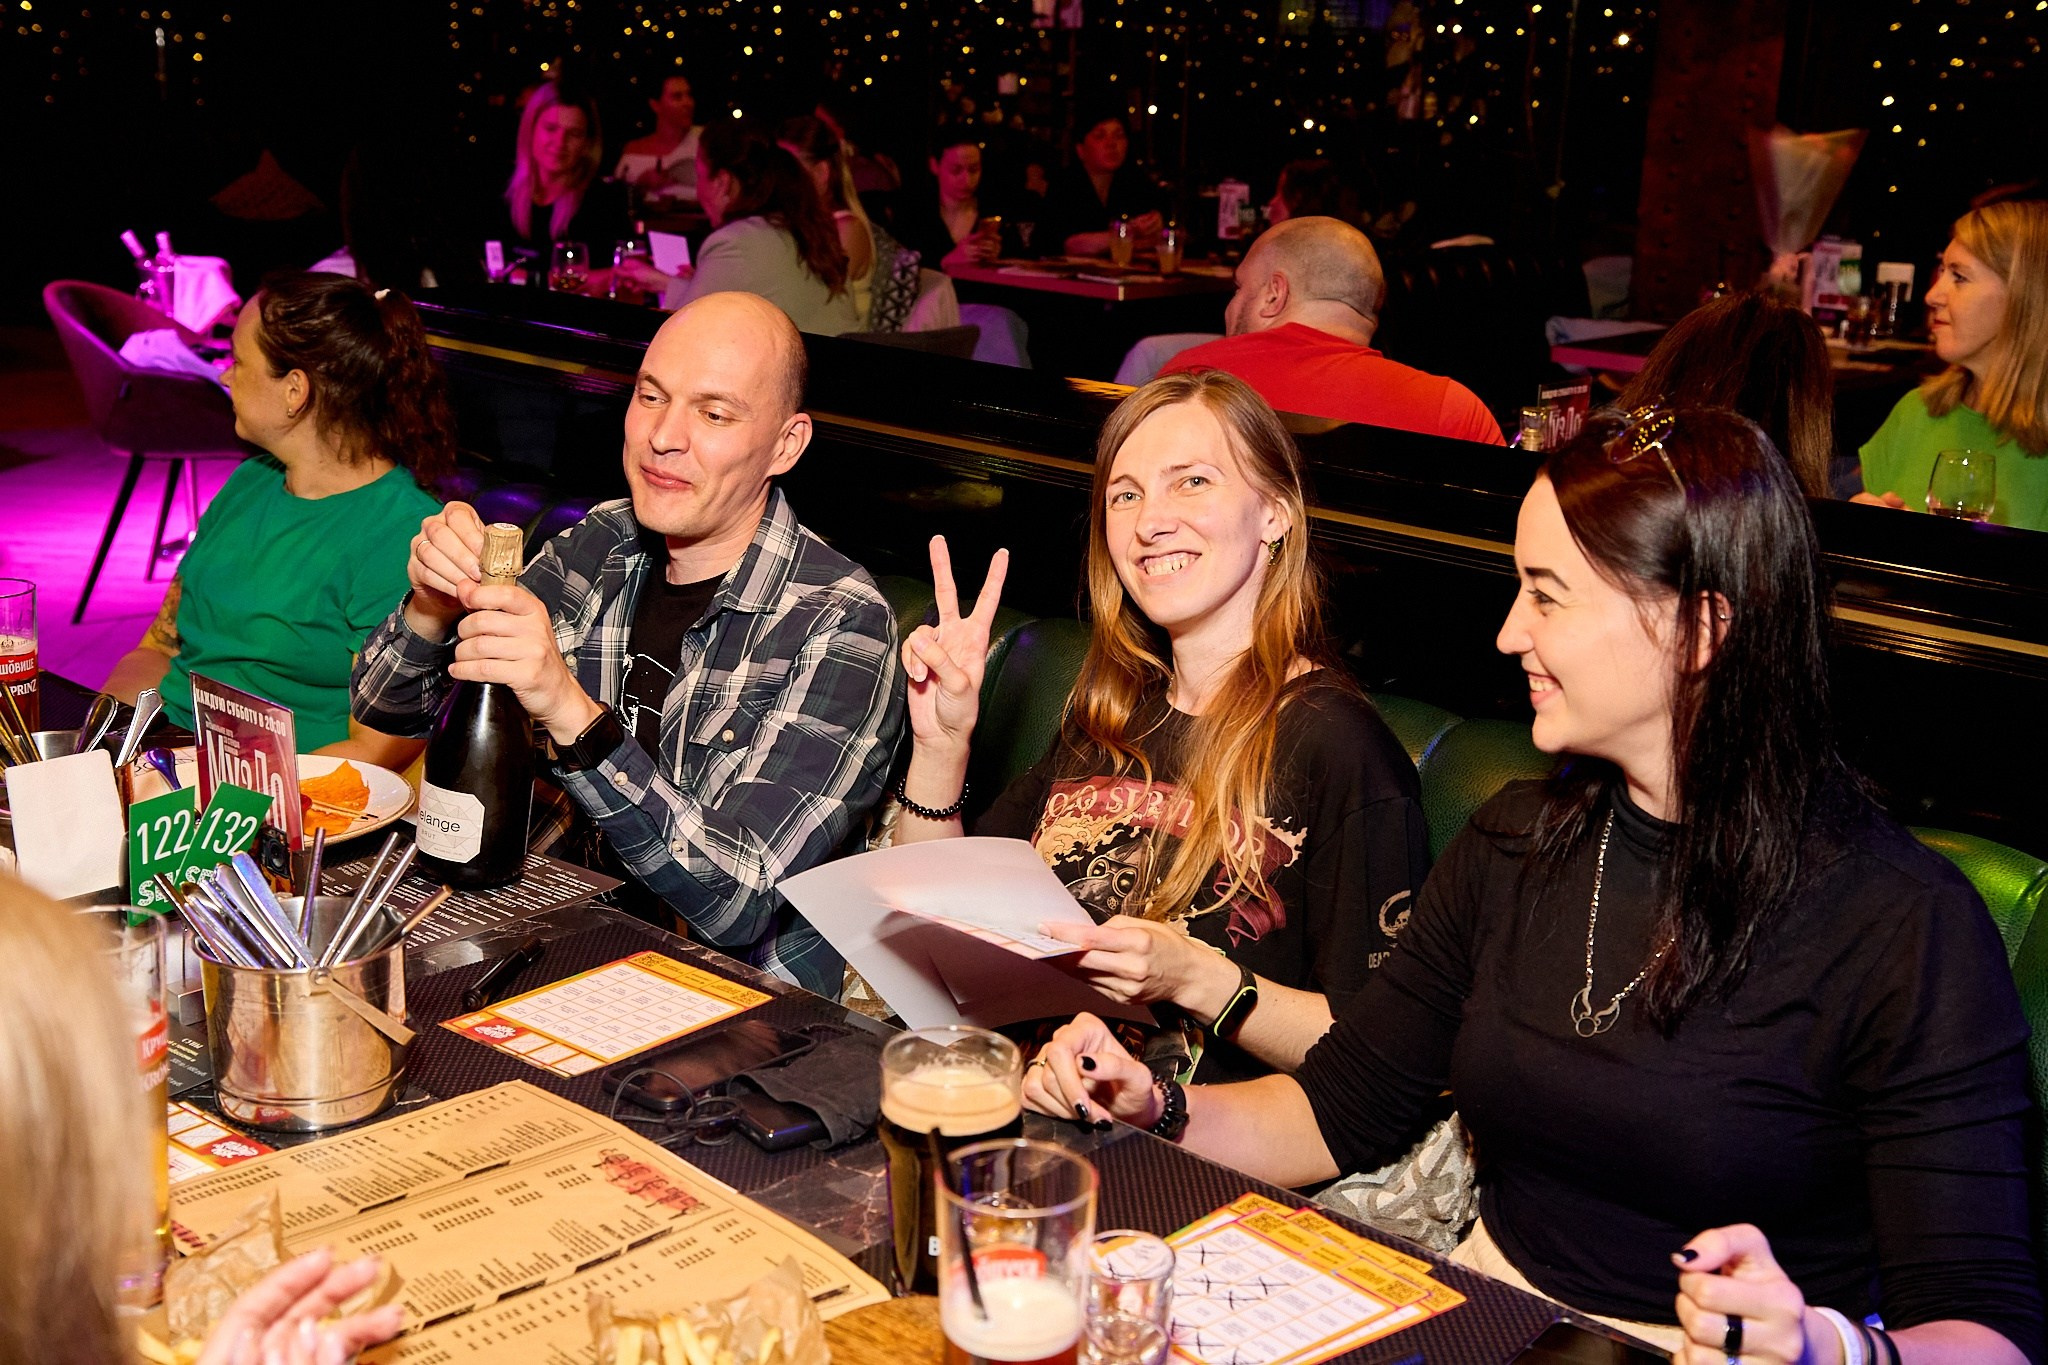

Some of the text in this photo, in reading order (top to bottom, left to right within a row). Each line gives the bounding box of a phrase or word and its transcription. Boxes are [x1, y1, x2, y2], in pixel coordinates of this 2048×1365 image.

[195, 688, 287, 737] КАЖДУЮ СУББОТУ В 20:00
[137, 809, 191, 865] 122
[200, 807, 257, 857] 132
